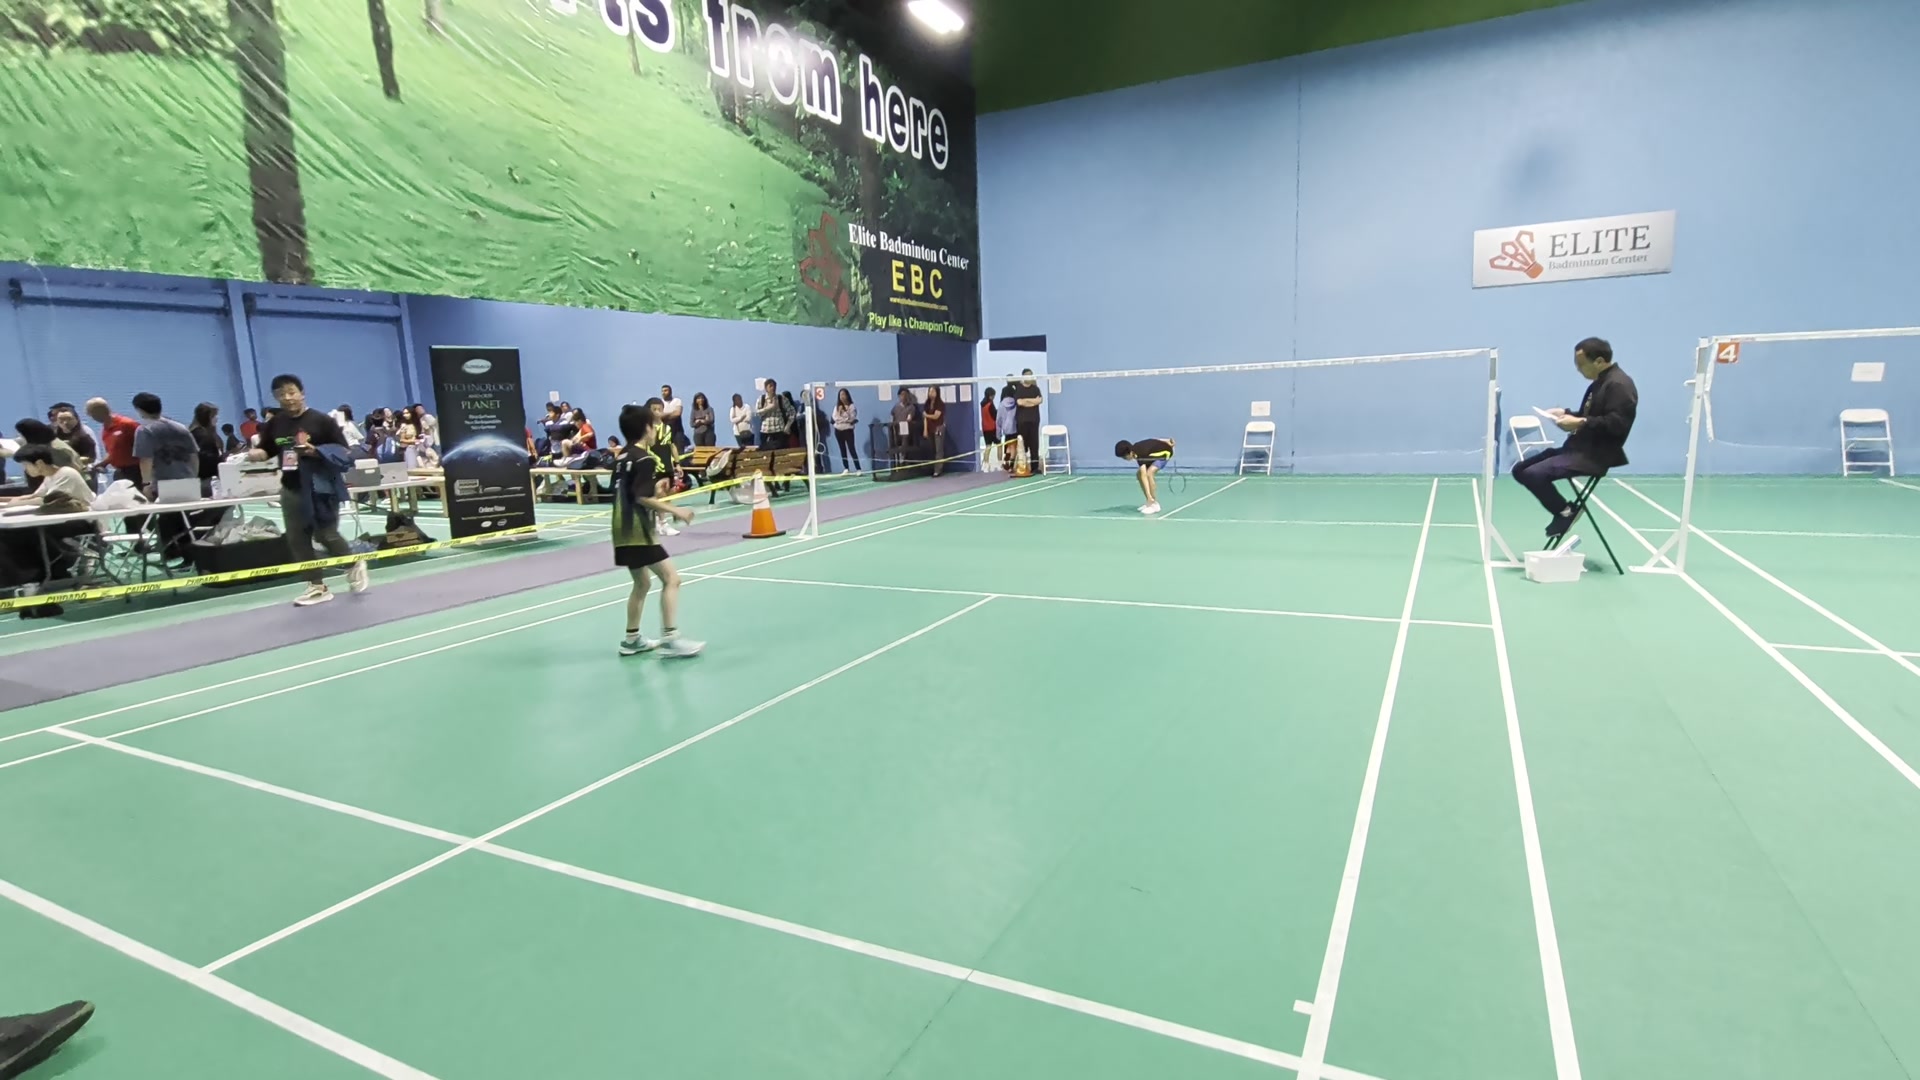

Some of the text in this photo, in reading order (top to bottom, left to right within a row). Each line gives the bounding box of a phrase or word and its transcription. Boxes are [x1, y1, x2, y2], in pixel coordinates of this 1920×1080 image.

[702, 0, 842, 125] from
[859, 53, 949, 170] here
[848, 223, 970, 270] Elite Badminton Center
[1549, 225, 1651, 258] ELITE
[1549, 254, 1648, 270] Badminton Center
[867, 312, 887, 329] Play
[888, 314, 902, 328] like
[908, 316, 944, 333] Champion
[1719, 344, 1737, 362] 4
[444, 383, 515, 392] TECHNOLOGY
[815, 387, 825, 400] 3
[461, 400, 501, 409] PLANET
[125, 583, 162, 593] CAUTION
[249, 567, 280, 577] CAUTION
